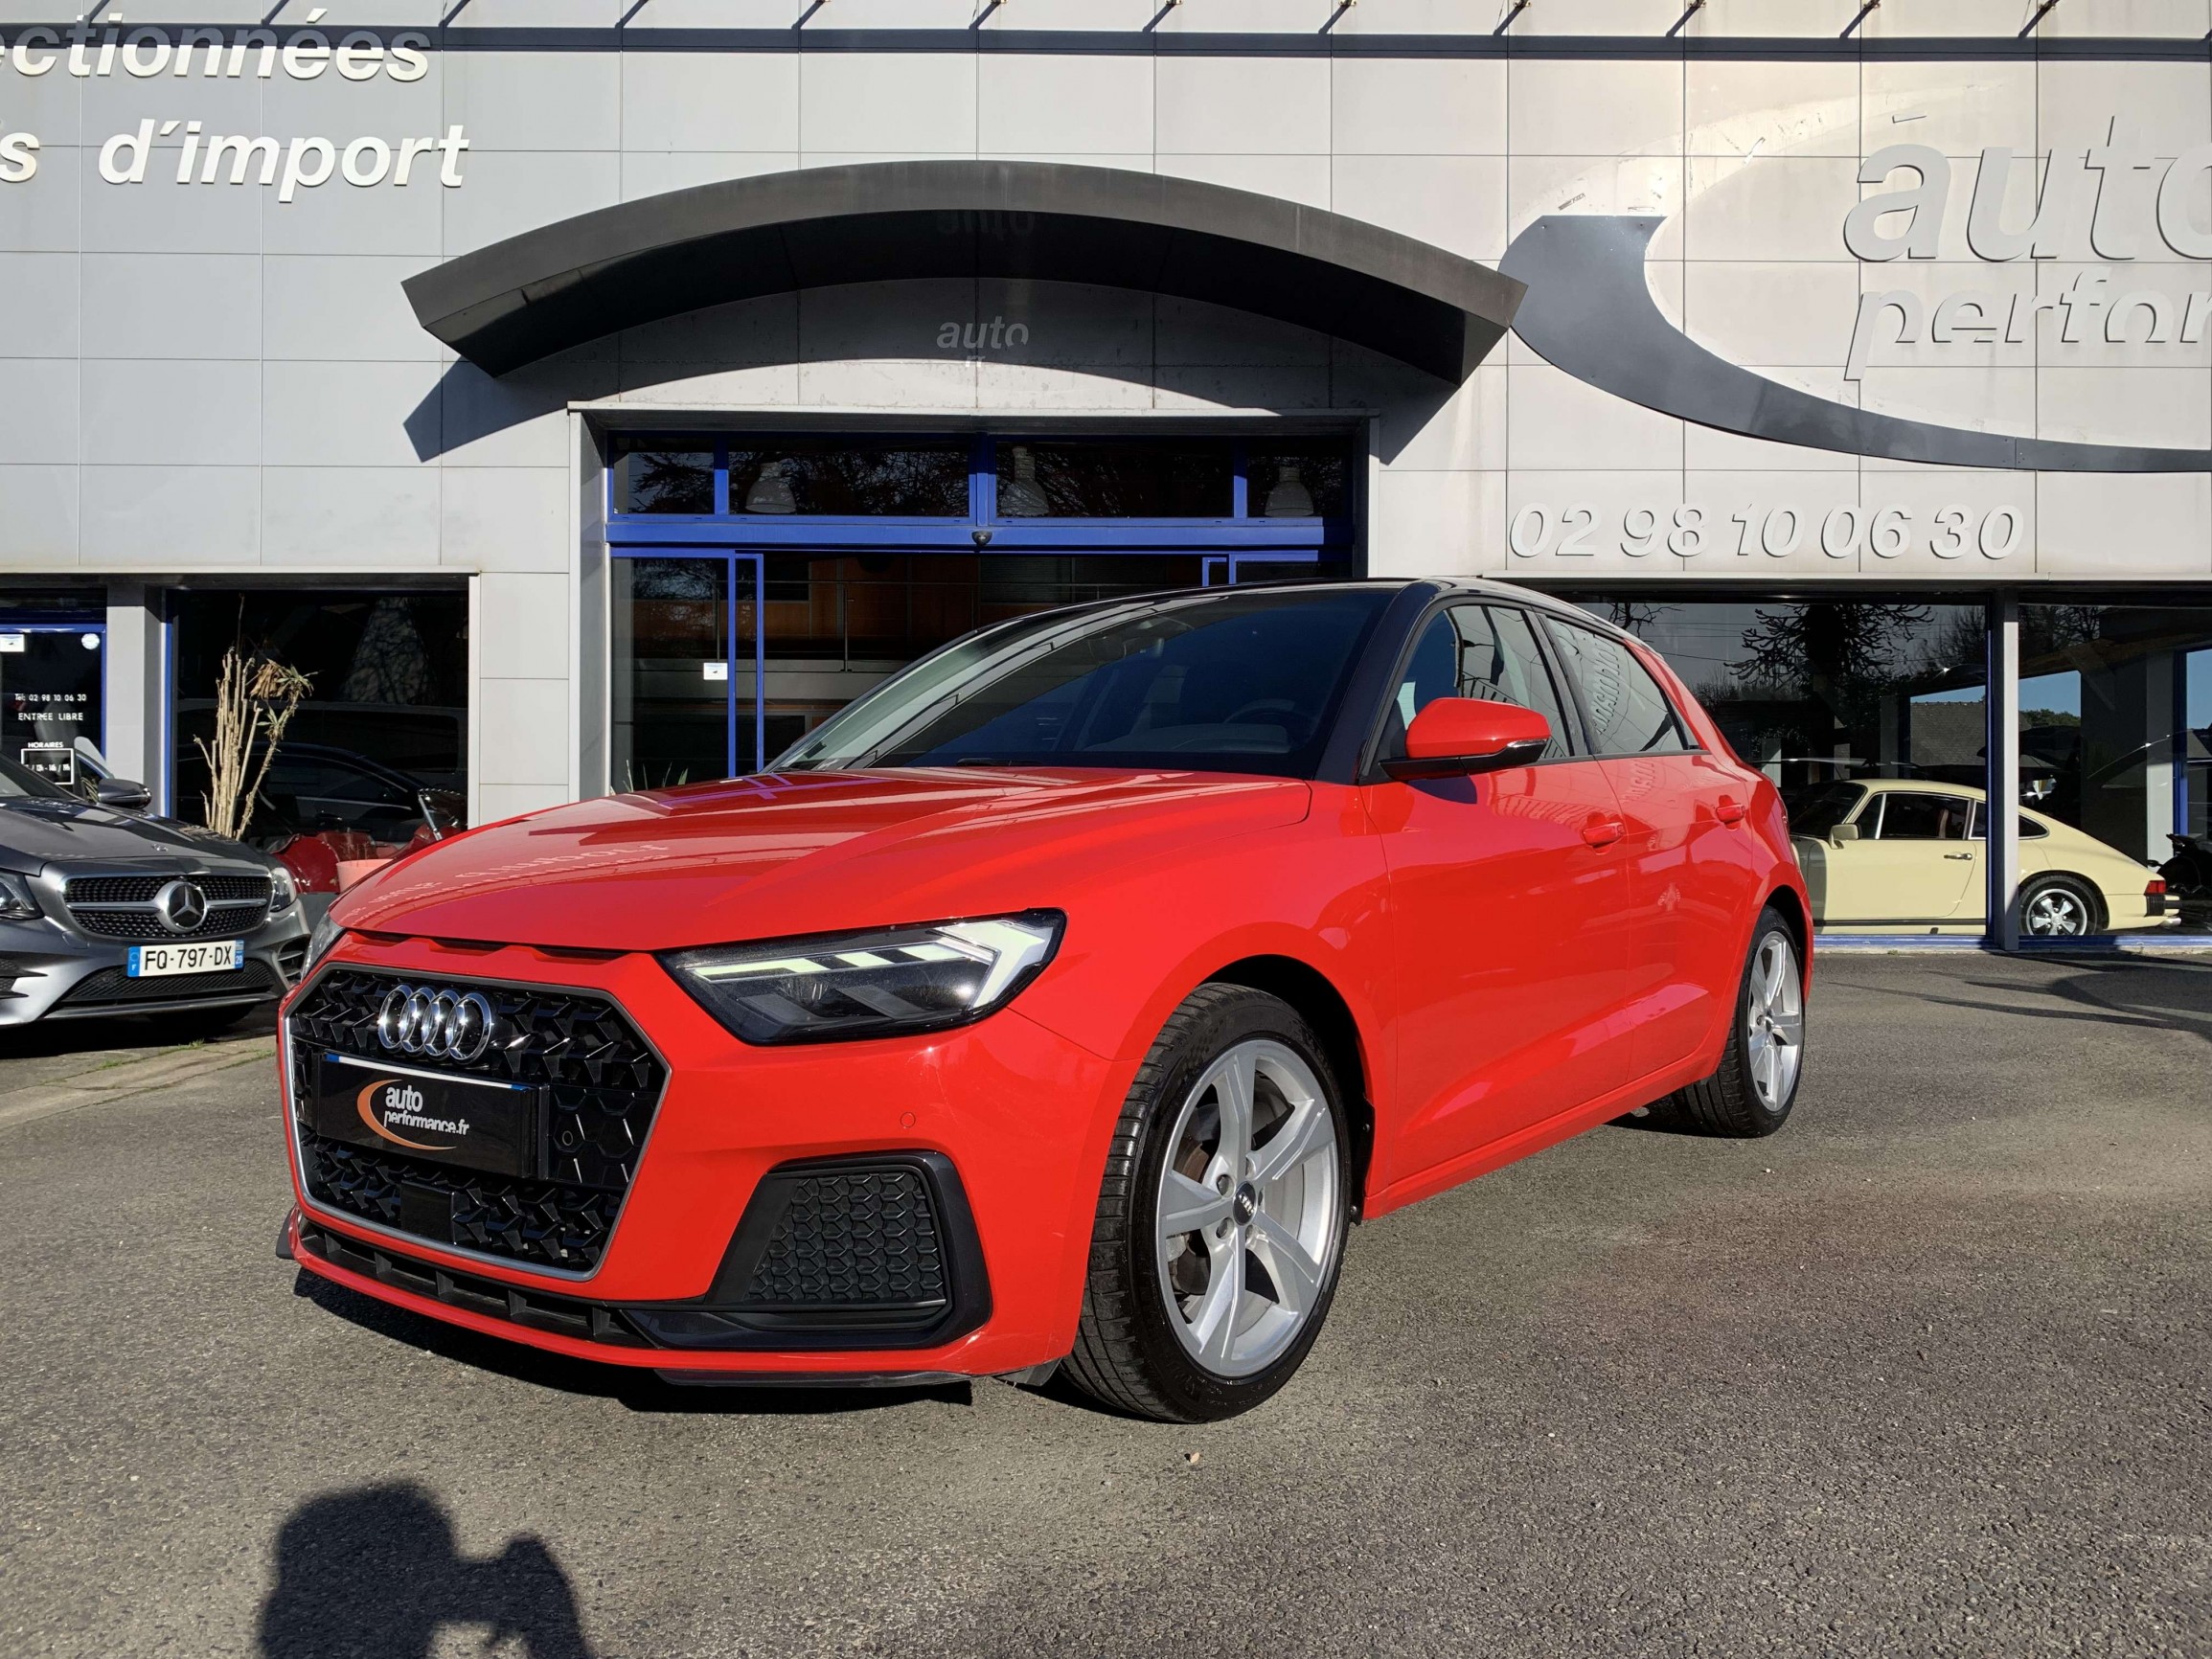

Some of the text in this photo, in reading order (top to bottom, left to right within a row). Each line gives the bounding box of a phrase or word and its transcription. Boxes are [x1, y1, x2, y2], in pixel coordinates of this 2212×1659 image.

[0, 8, 431, 82] ctionnées
[936, 316, 1029, 350] auto
[1510, 503, 2024, 558] 02 98 10 06 30
[29, 693, 38, 702] 02
[54, 693, 61, 702] 10
[58, 712, 83, 721] LIBRE
[145, 945, 232, 970] FQ-797-DX
[385, 1084, 423, 1112] auto
[383, 1109, 469, 1136] performance.fr
